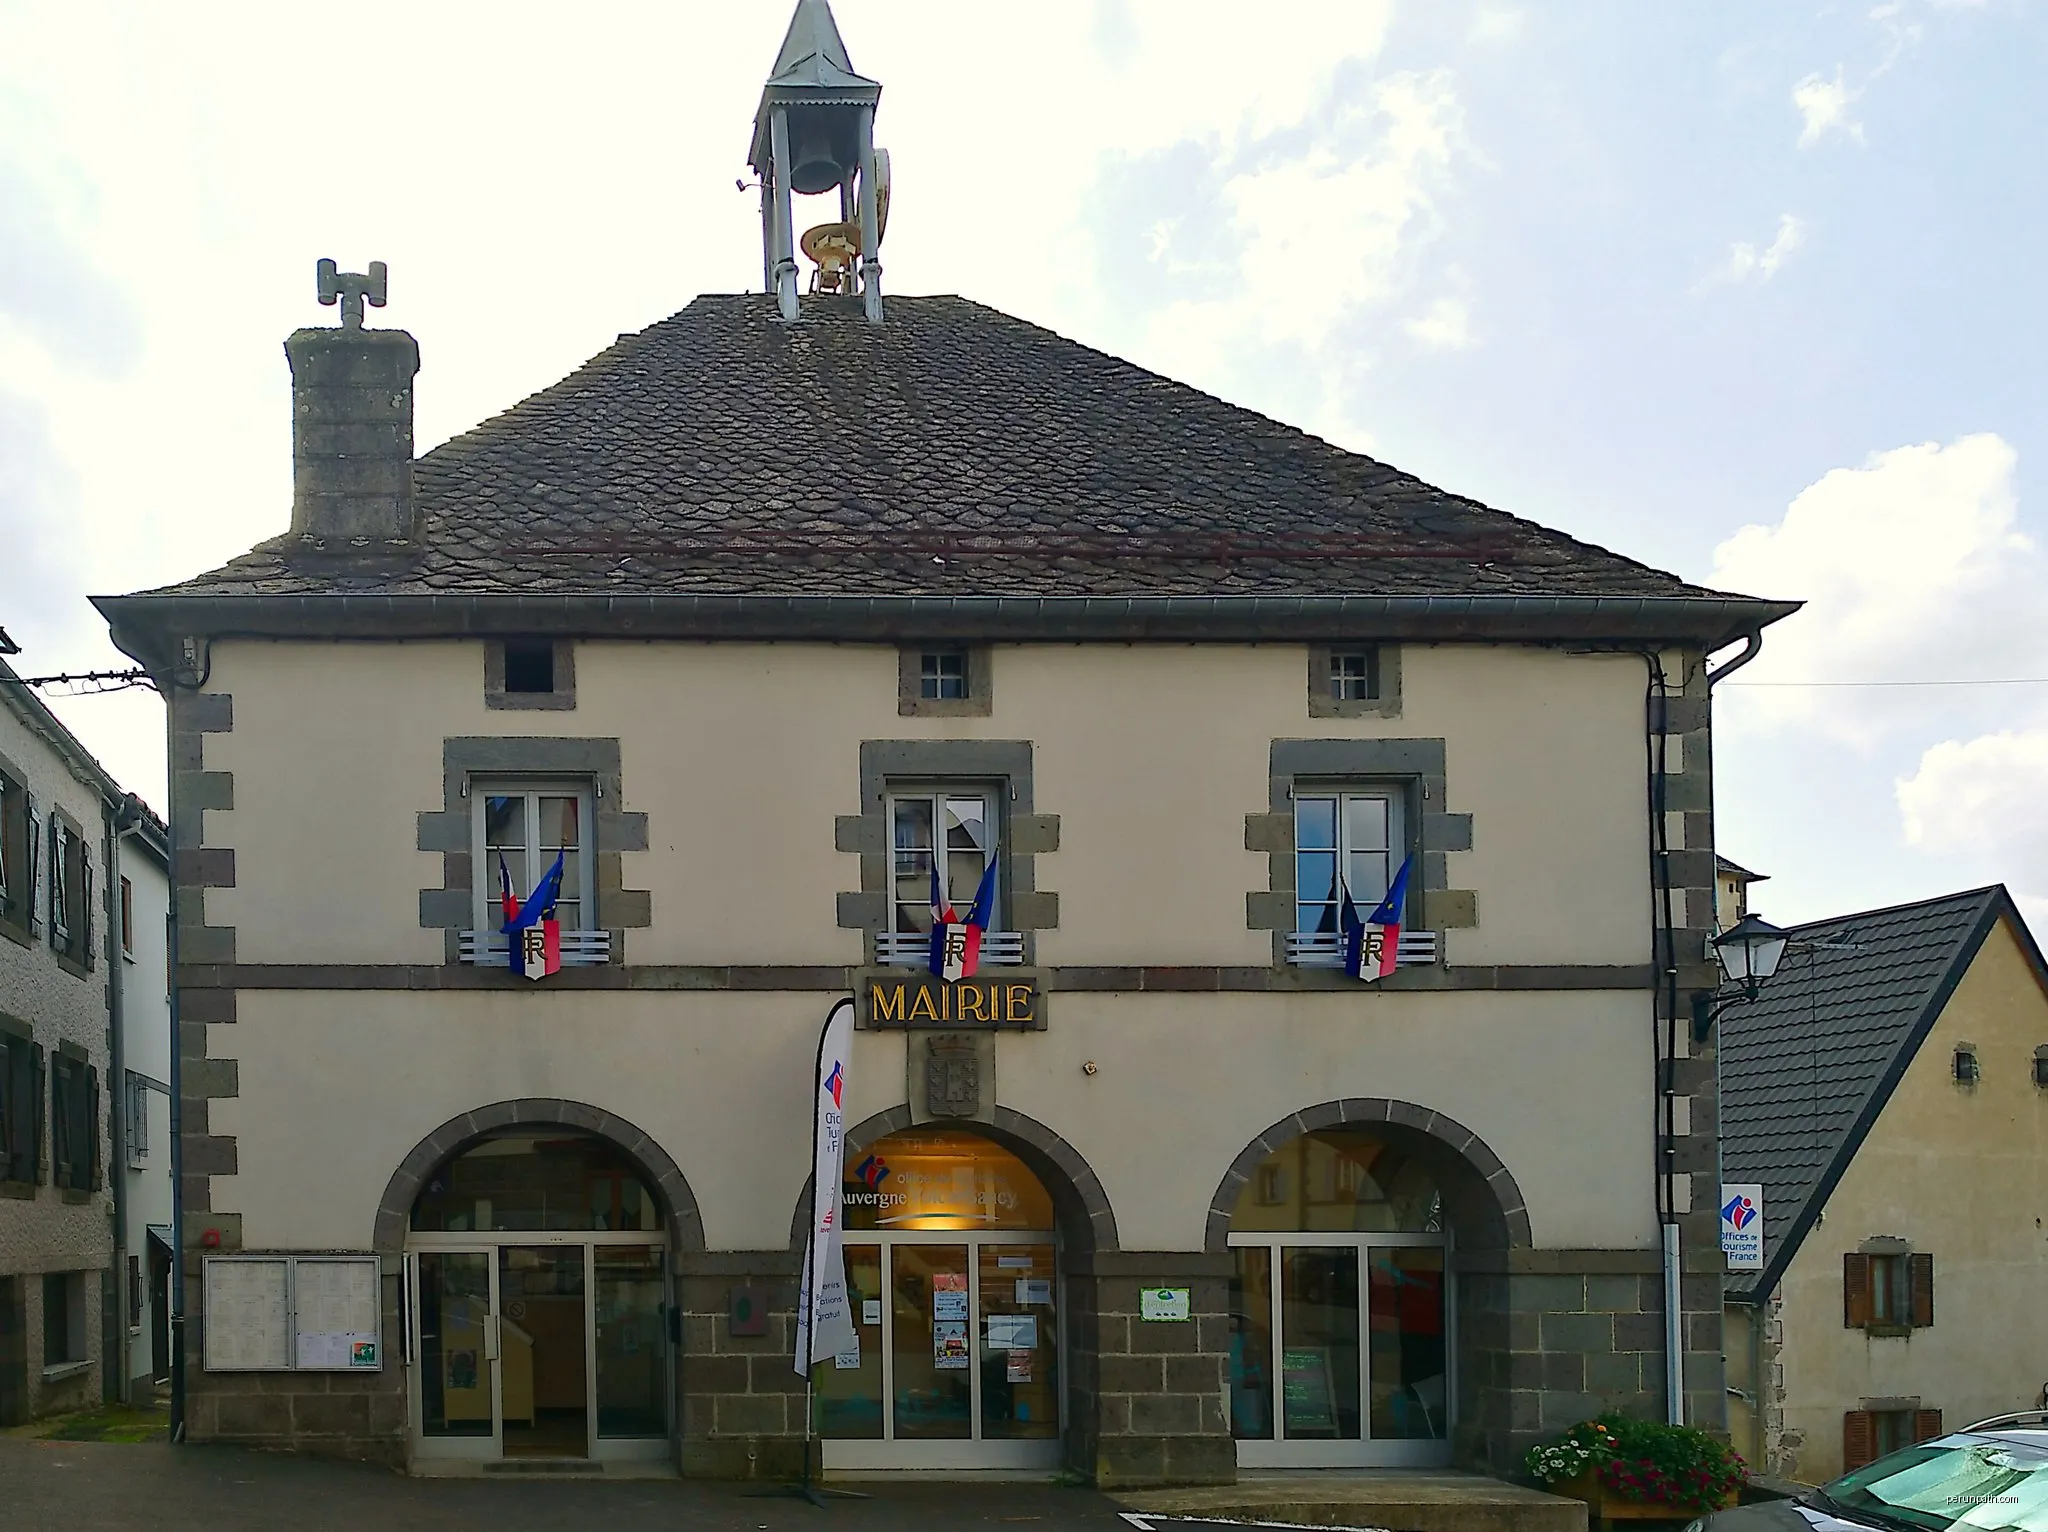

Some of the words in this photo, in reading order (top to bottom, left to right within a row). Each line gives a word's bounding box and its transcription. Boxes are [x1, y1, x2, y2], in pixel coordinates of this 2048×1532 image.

[872, 983, 1034, 1022] MAIRIE
[1721, 1243, 1758, 1251] ourisme
[1729, 1251, 1758, 1261] France
